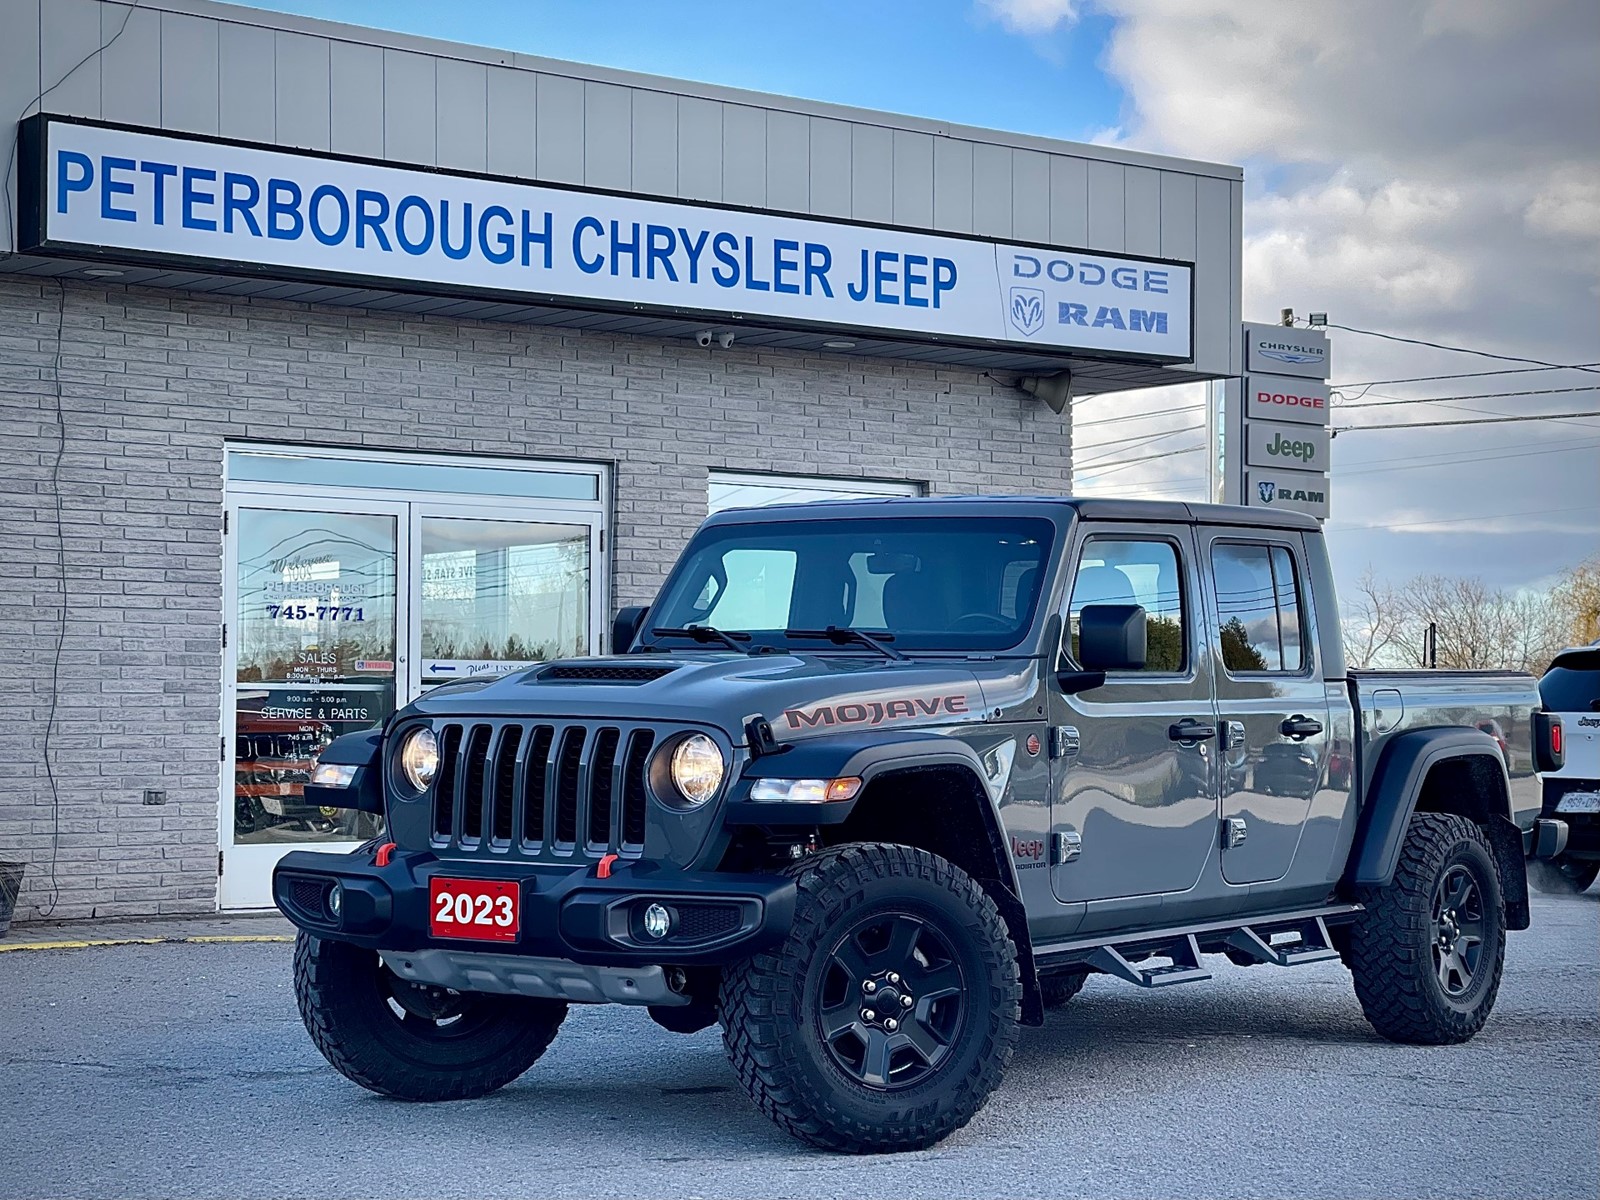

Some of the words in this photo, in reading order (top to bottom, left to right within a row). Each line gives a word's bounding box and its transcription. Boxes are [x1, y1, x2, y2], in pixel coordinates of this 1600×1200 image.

[57, 149, 553, 270] PETERBOROUGH
[571, 215, 834, 299] CHRYSLER
[847, 248, 958, 310] JEEP
[1012, 254, 1169, 294] DODGE
[1057, 301, 1169, 334] RAM
[1258, 341, 1324, 356] CHRYSLER
[1257, 391, 1325, 409] DODGE
[1266, 432, 1315, 463] Jeep
[1278, 488, 1324, 503] RAM
[268, 604, 365, 622] 745-7771
[298, 652, 337, 664] SALES
[260, 708, 312, 719] SERVICE
[317, 708, 325, 719] &
[330, 708, 368, 719] PARTS
[784, 695, 968, 729] MOJAVE
[1011, 835, 1045, 861] Jeep
[434, 891, 515, 928] 2023
